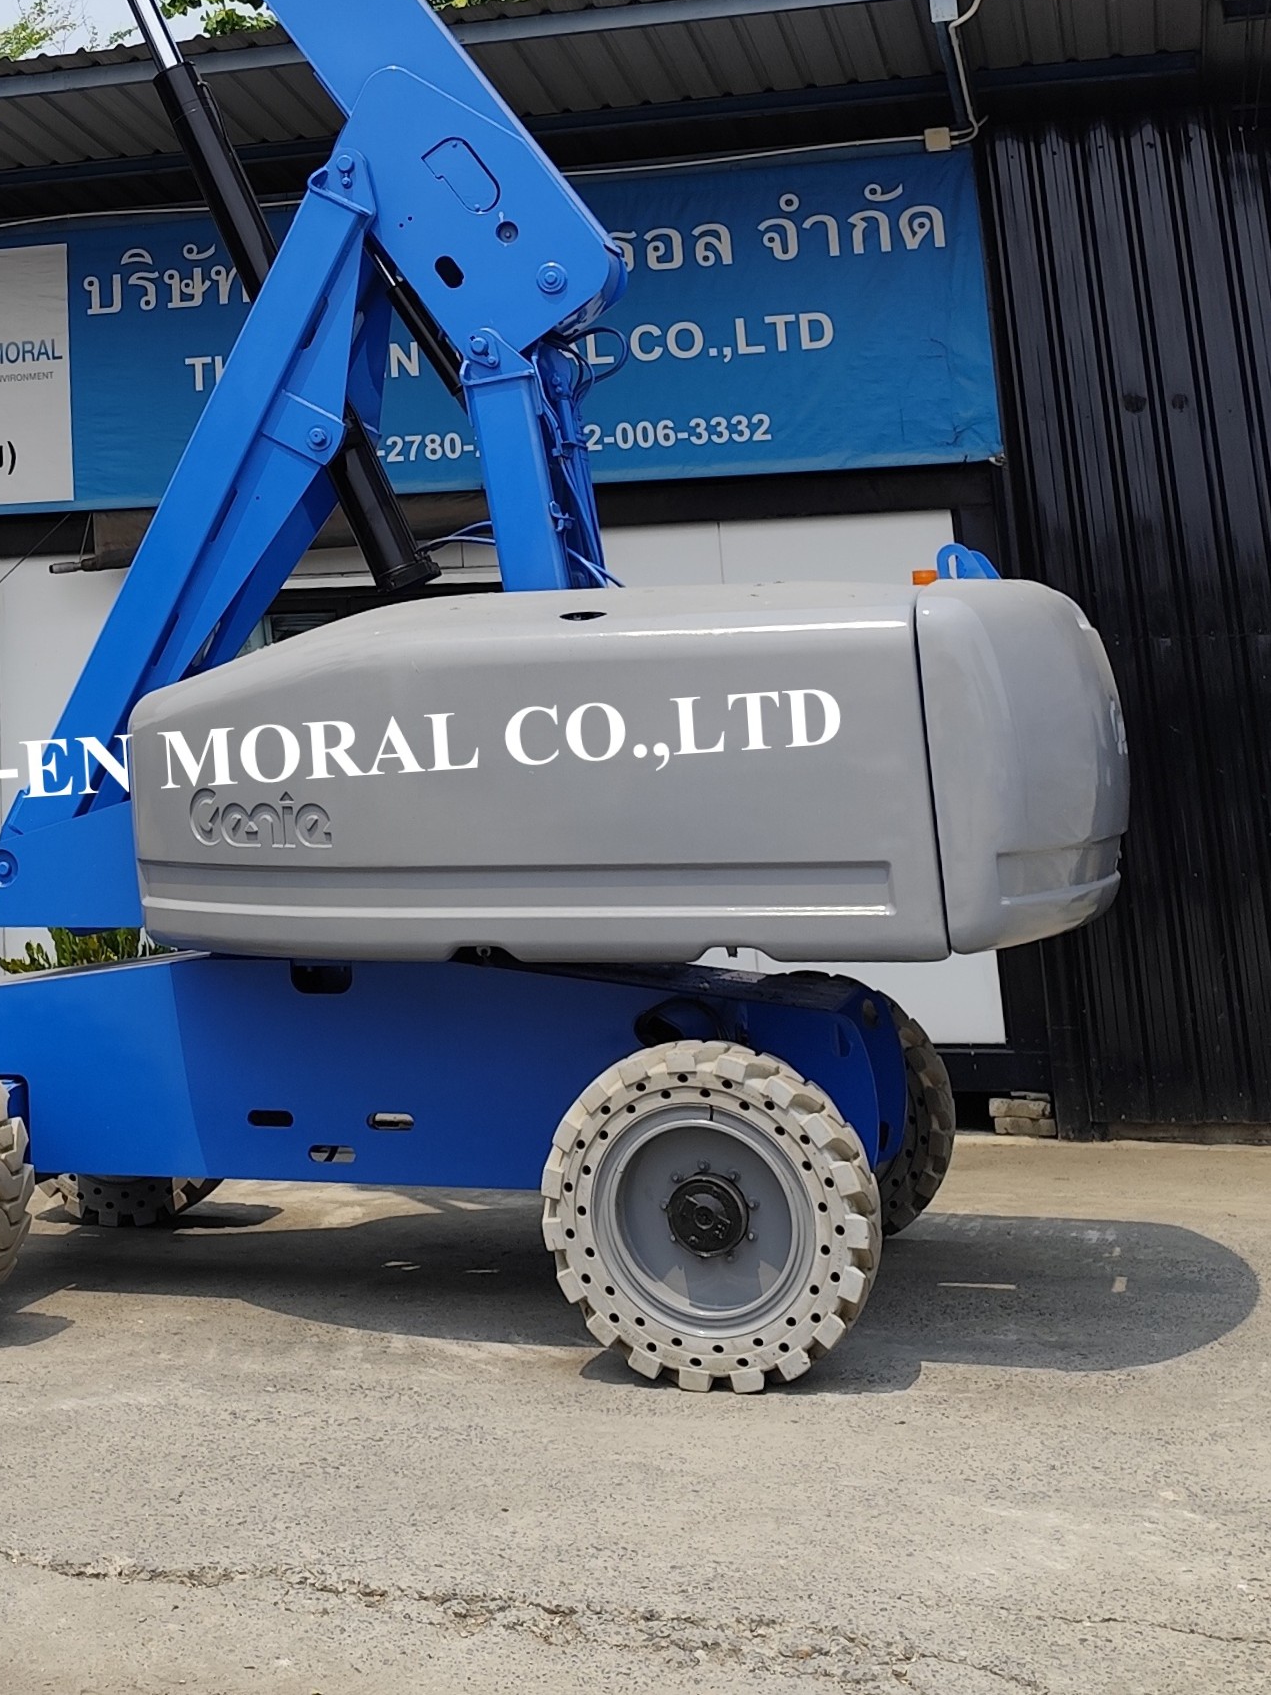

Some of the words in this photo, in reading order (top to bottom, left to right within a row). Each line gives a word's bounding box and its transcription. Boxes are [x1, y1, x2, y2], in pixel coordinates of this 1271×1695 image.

[608, 223, 734, 273] รอล
[757, 183, 946, 262] จำกัด
[630, 311, 835, 363] CO.,LTD
[377, 432, 481, 463] -2780-
[584, 413, 772, 452] 2-006-3332
[189, 788, 333, 848] Genie
